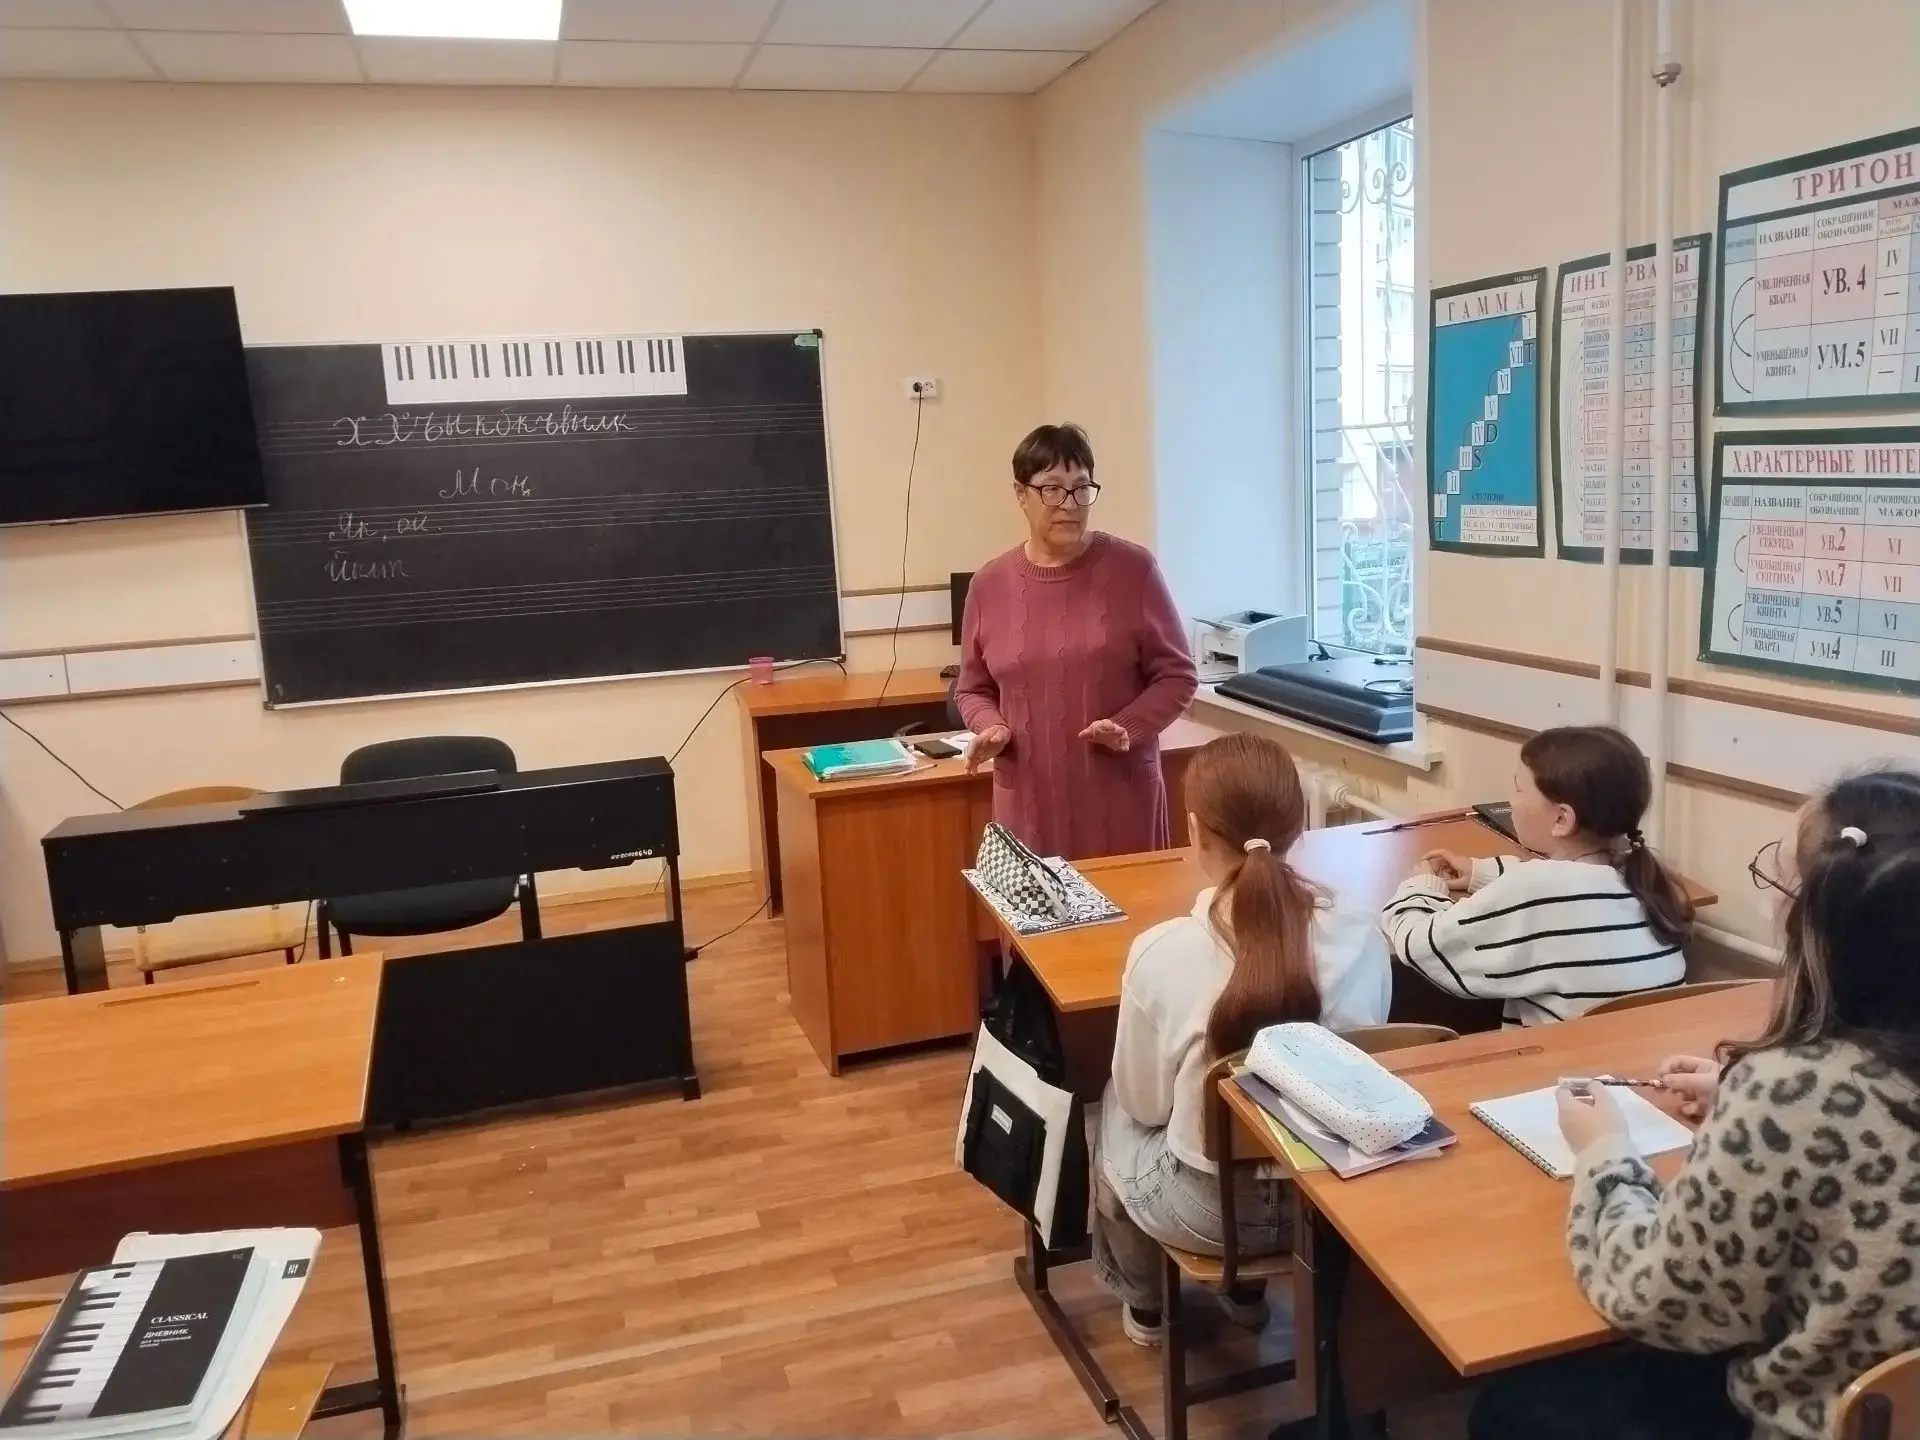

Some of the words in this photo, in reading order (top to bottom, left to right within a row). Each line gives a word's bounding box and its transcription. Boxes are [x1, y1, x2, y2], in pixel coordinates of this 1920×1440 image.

[1793, 151, 1914, 200] ТРИТОН
[1759, 226, 1810, 245] НАЗВАНИЕ
[1817, 224, 1873, 240] ОБОЗНАЧЕНИЕ
[1886, 249, 1901, 267] IV
[1571, 254, 1689, 293] ИНТРВАЫ
[1757, 273, 1811, 290] УВЕЛИЧЕННАЯ
[1447, 290, 1525, 321] ГАММА
[1768, 292, 1797, 306] КВАРТА
[1880, 327, 1898, 345] VII
[1765, 365, 1796, 377] КВИНТА
[1486, 423, 1498, 443] D
[1474, 449, 1482, 468] S
[1733, 449, 1856, 474] ХАРАКТЕРНЫЕ
[1865, 449, 1920, 474] ИНТЕ
[1754, 497, 1803, 509] НАЗВАНИЕ
[1751, 523, 1804, 537] УВЕЛИЧЕННАЯ
[1759, 537, 1794, 550] СЕКУНДА
[1888, 537, 1903, 554] VI
[1756, 572, 1795, 585] СЕПТИМА
[1884, 576, 1902, 593] VII
[1747, 592, 1800, 608] УВЕЛИЧЕННАЯ
[1757, 605, 1787, 619] КВИНТА
[1884, 613, 1899, 630] VI
[1754, 640, 1781, 653] КВАРТА
[1880, 650, 1896, 667] III
[151, 1312, 208, 1324] CLASSICAL
[143, 1328, 190, 1339] ДНЕВНИК
